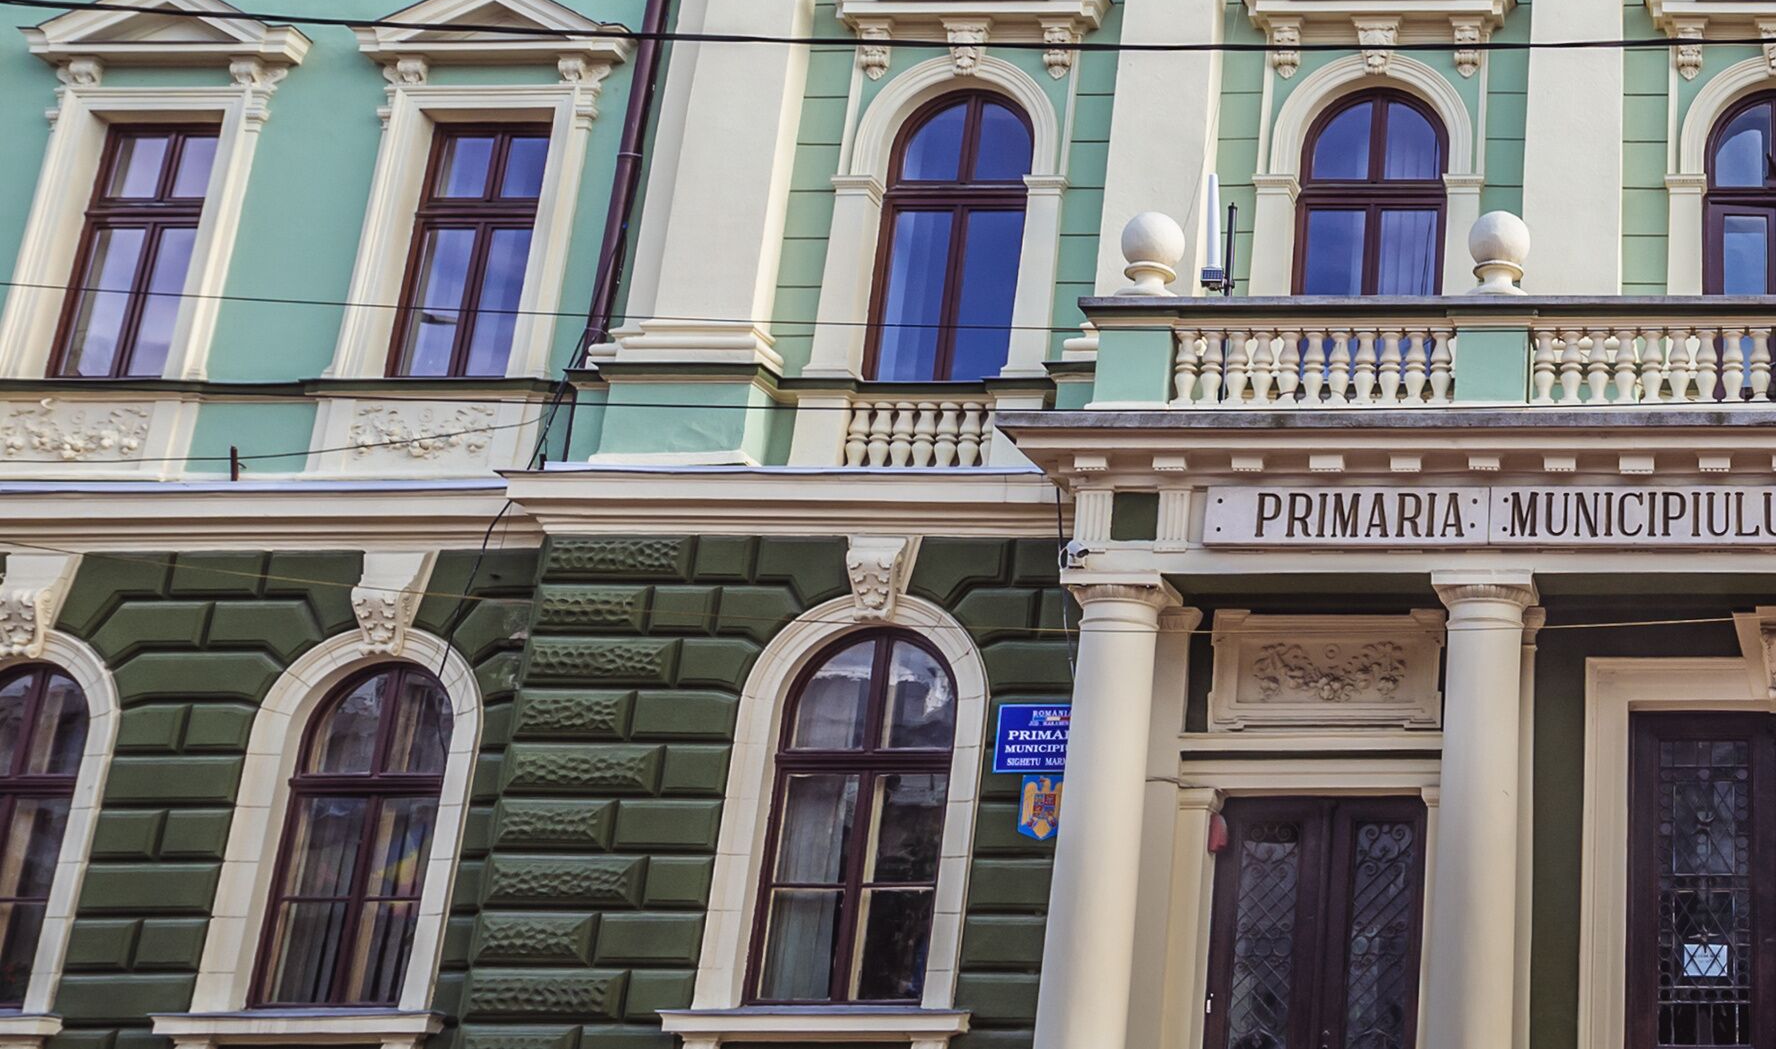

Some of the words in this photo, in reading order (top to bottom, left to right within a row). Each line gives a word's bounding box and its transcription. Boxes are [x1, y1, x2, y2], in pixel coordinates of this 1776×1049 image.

[1255, 492, 1465, 538] PRIMARIA
[1004, 744, 1068, 753] MUNICIPI
[1007, 757, 1041, 766] SIGHETU
